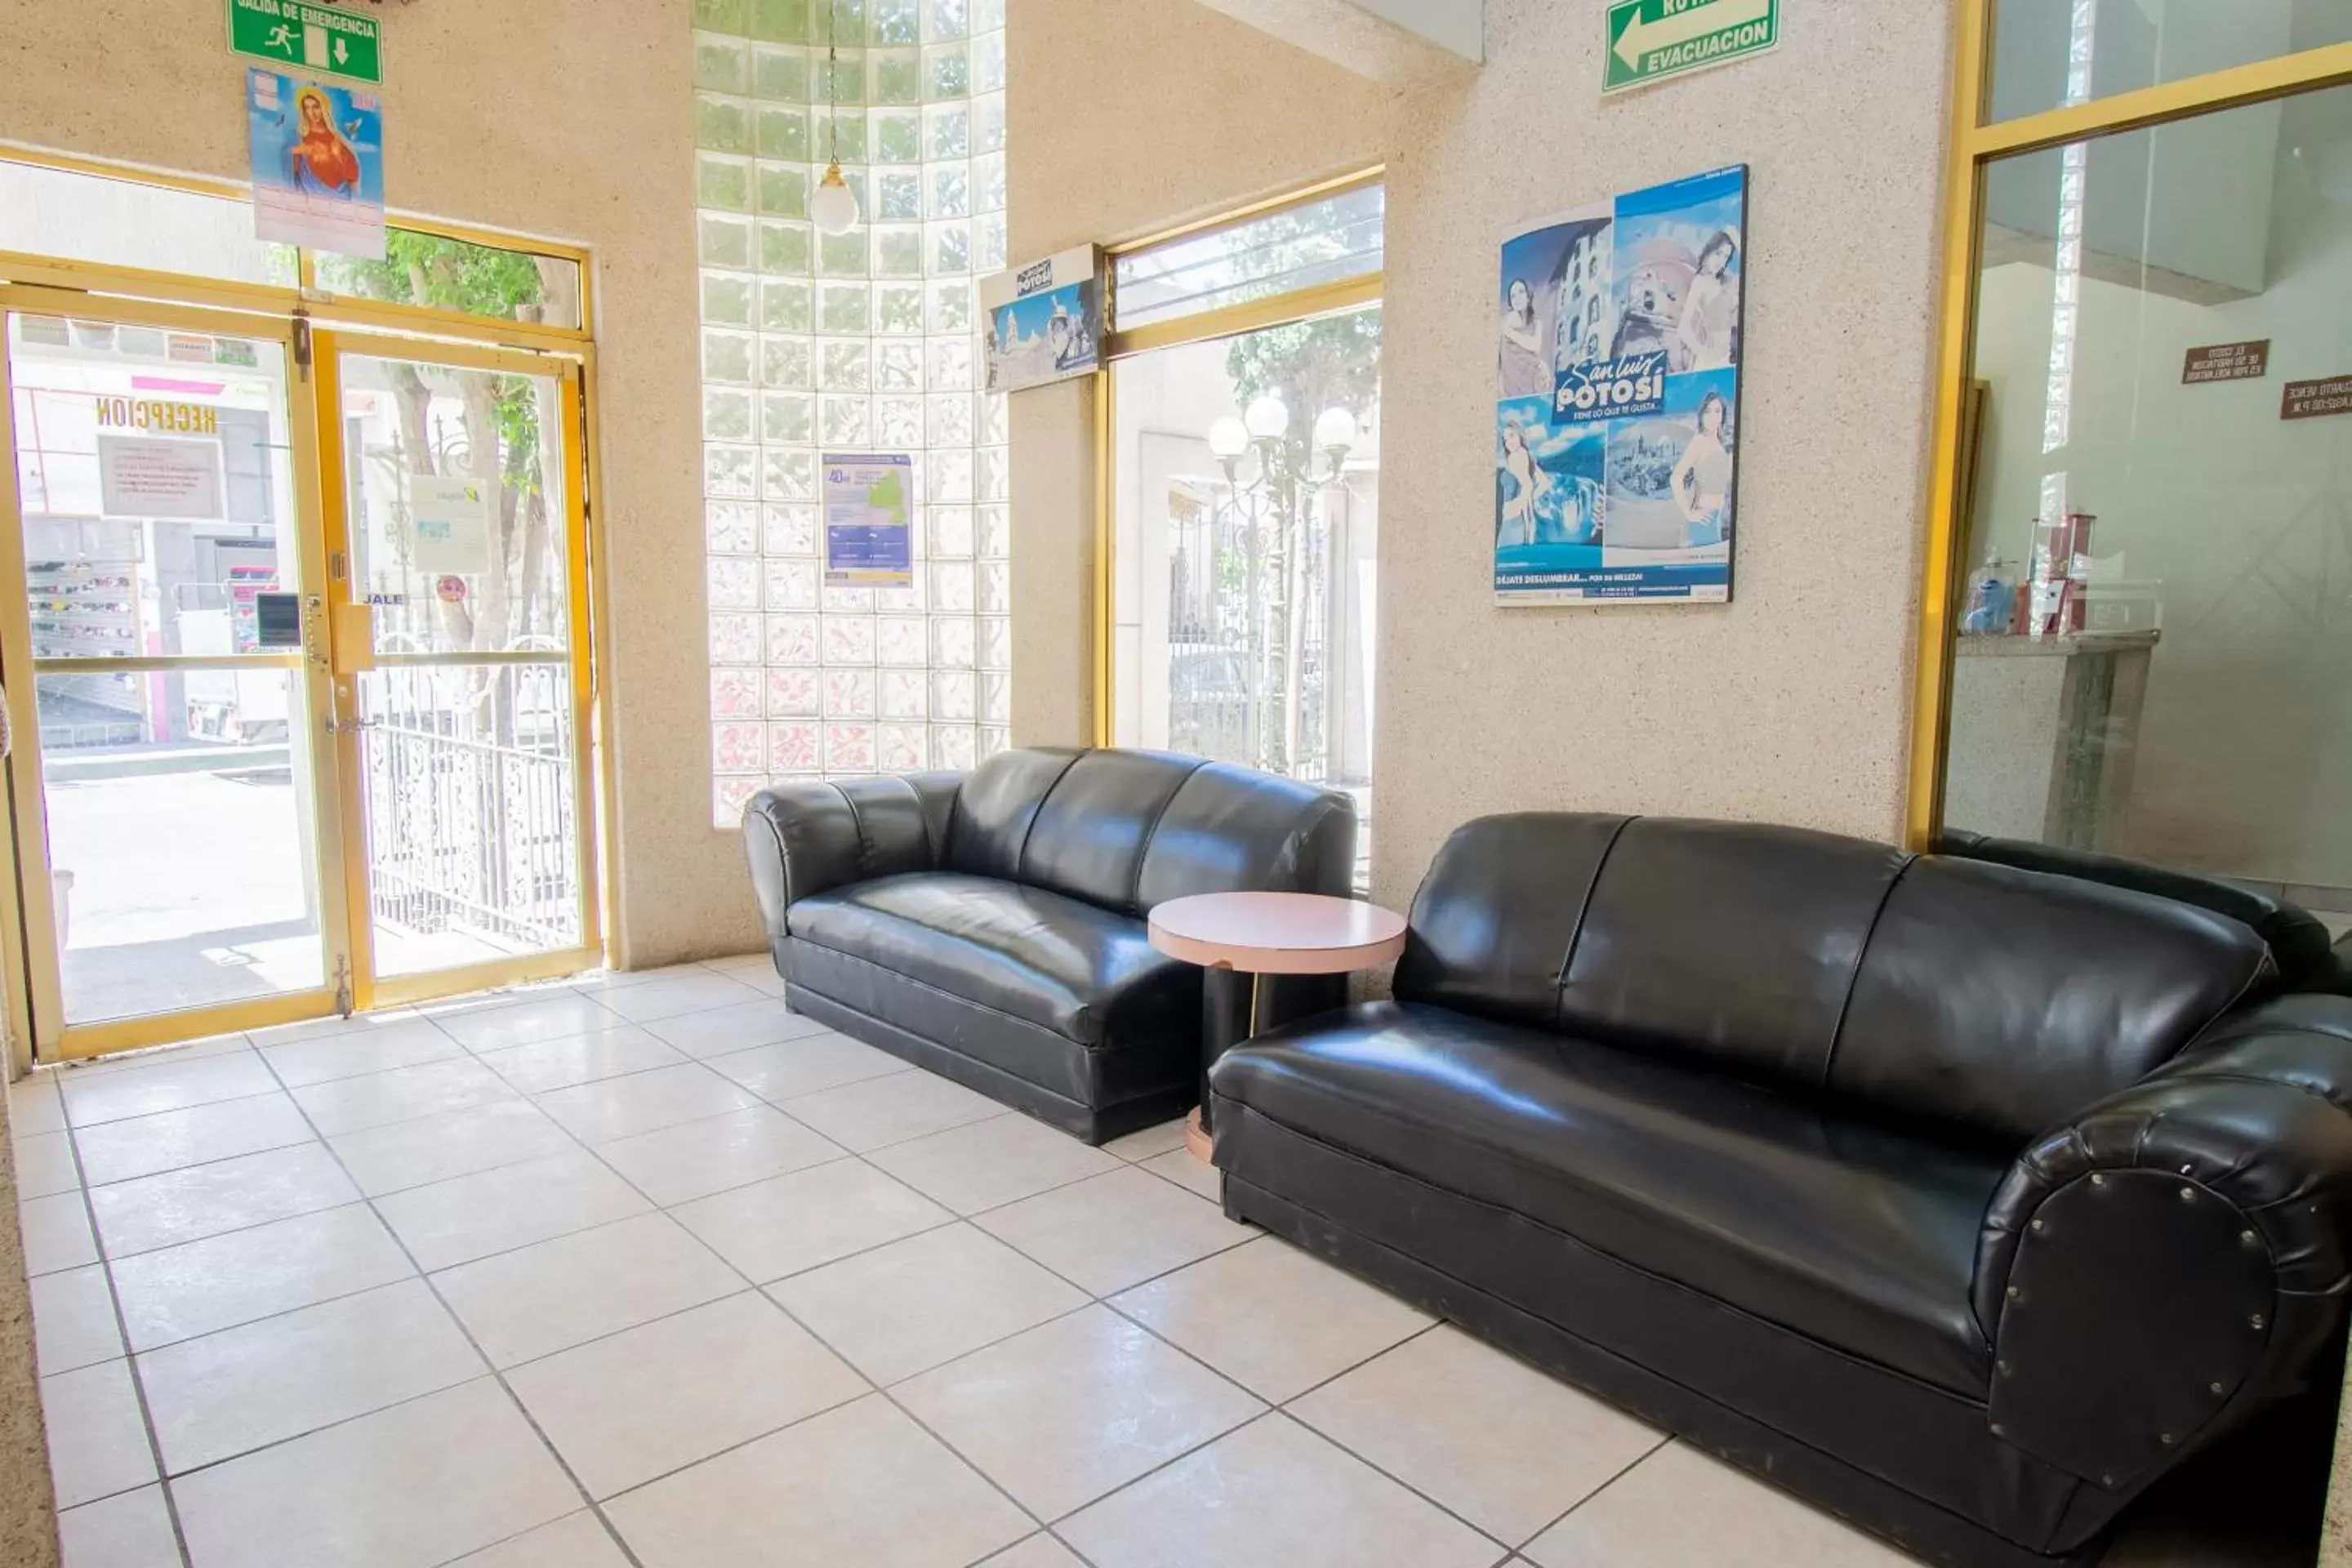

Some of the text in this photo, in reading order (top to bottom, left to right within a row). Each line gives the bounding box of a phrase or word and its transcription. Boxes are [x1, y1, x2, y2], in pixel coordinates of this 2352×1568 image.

[283, 4, 298, 20] DE
[301, 7, 375, 38] EMERGENCIA
[1647, 20, 1768, 73] EVACUACION
[1557, 367, 1664, 412] POTOSÍ
[363, 594, 403, 604] JALE
